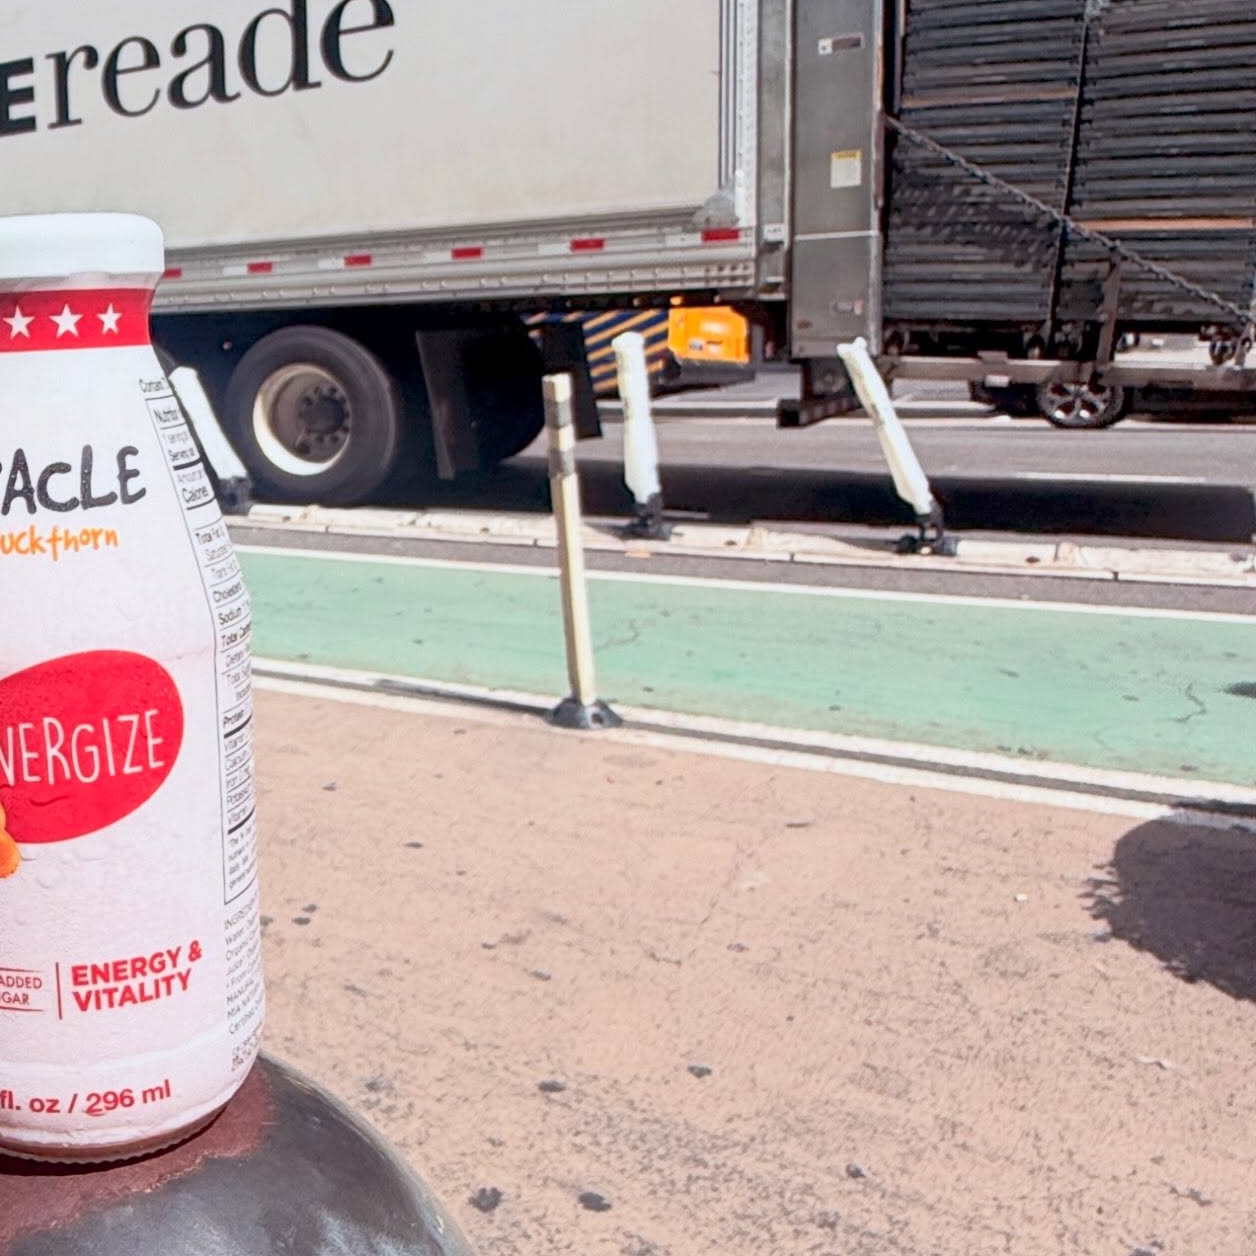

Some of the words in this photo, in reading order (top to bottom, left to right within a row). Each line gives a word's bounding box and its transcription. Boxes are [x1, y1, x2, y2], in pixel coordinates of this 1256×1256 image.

[71, 946, 182, 987] ENERGY
[188, 940, 202, 963] &
[72, 968, 192, 1012] VITALITY
[29, 1097, 61, 1114] oz
[67, 1093, 78, 1114] /
[84, 1088, 136, 1117] 296
[141, 1079, 172, 1104] ml
